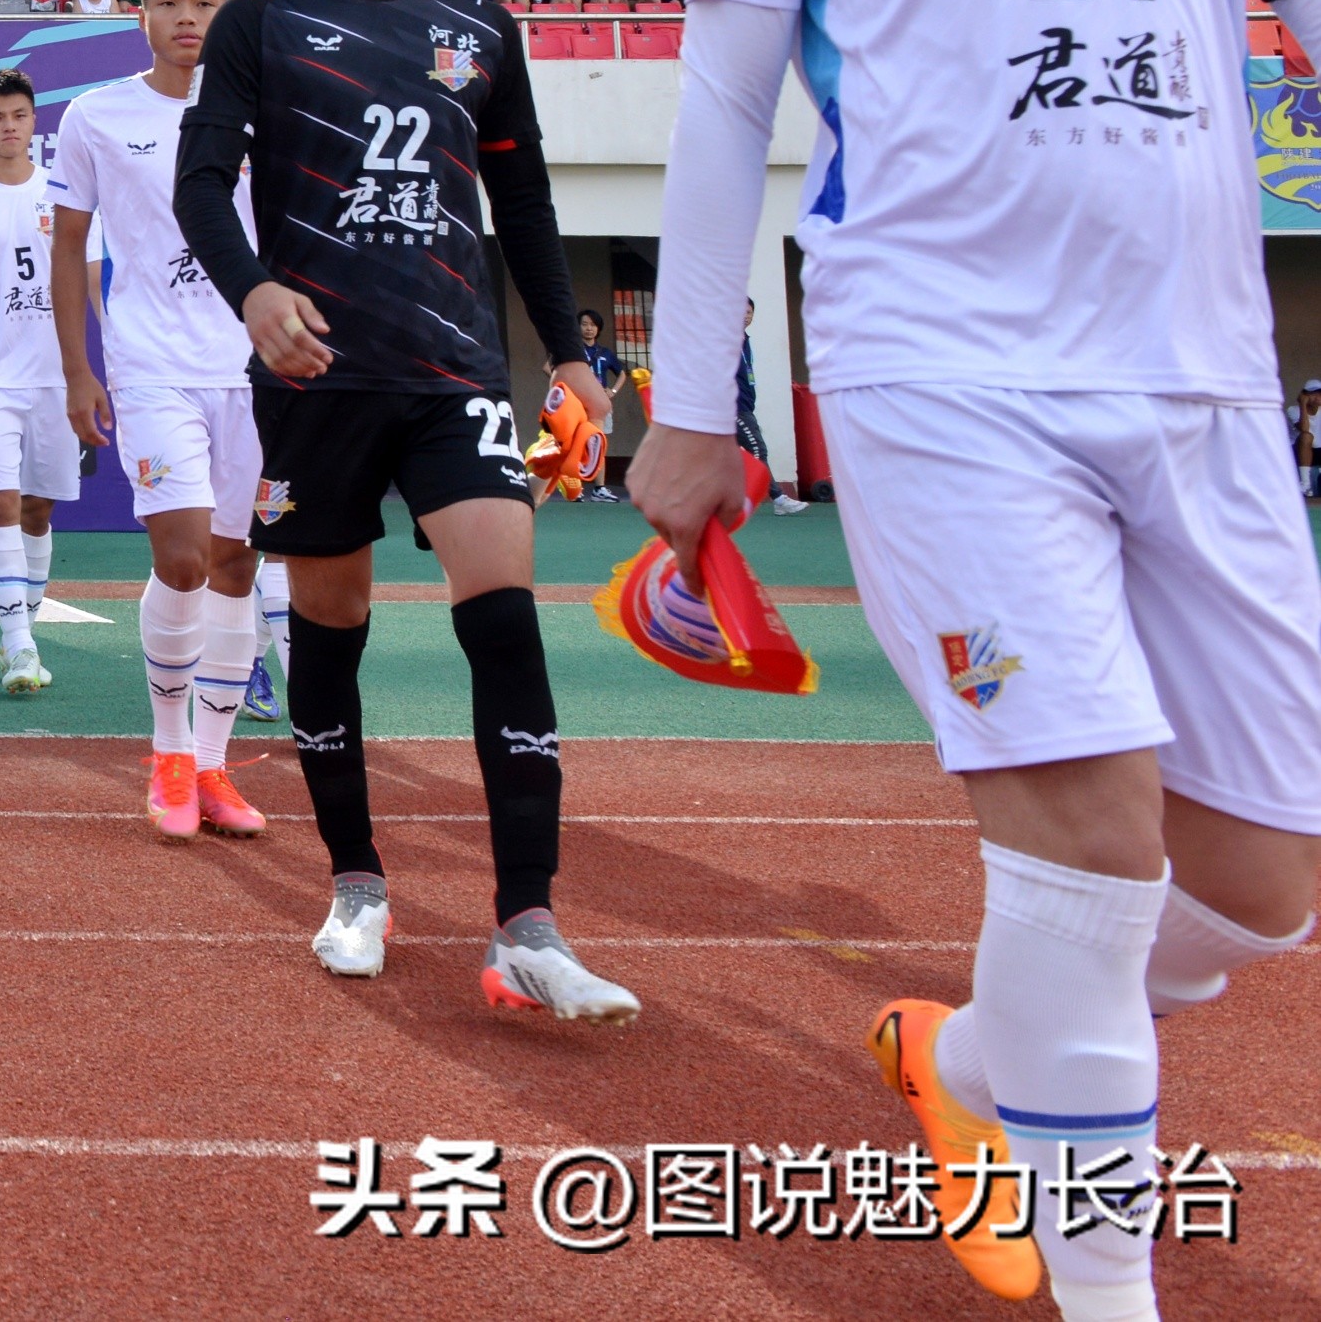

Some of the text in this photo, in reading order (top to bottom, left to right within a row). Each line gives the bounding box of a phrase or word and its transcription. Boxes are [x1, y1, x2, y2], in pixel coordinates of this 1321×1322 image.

[428, 25, 481, 53] 河北
[1007, 27, 1196, 122] 君道
[363, 104, 431, 173] 22
[336, 176, 437, 231] 君道
[344, 232, 433, 246] 东方好酱酒
[14, 246, 35, 281] 5
[4, 286, 52, 315] 君道
